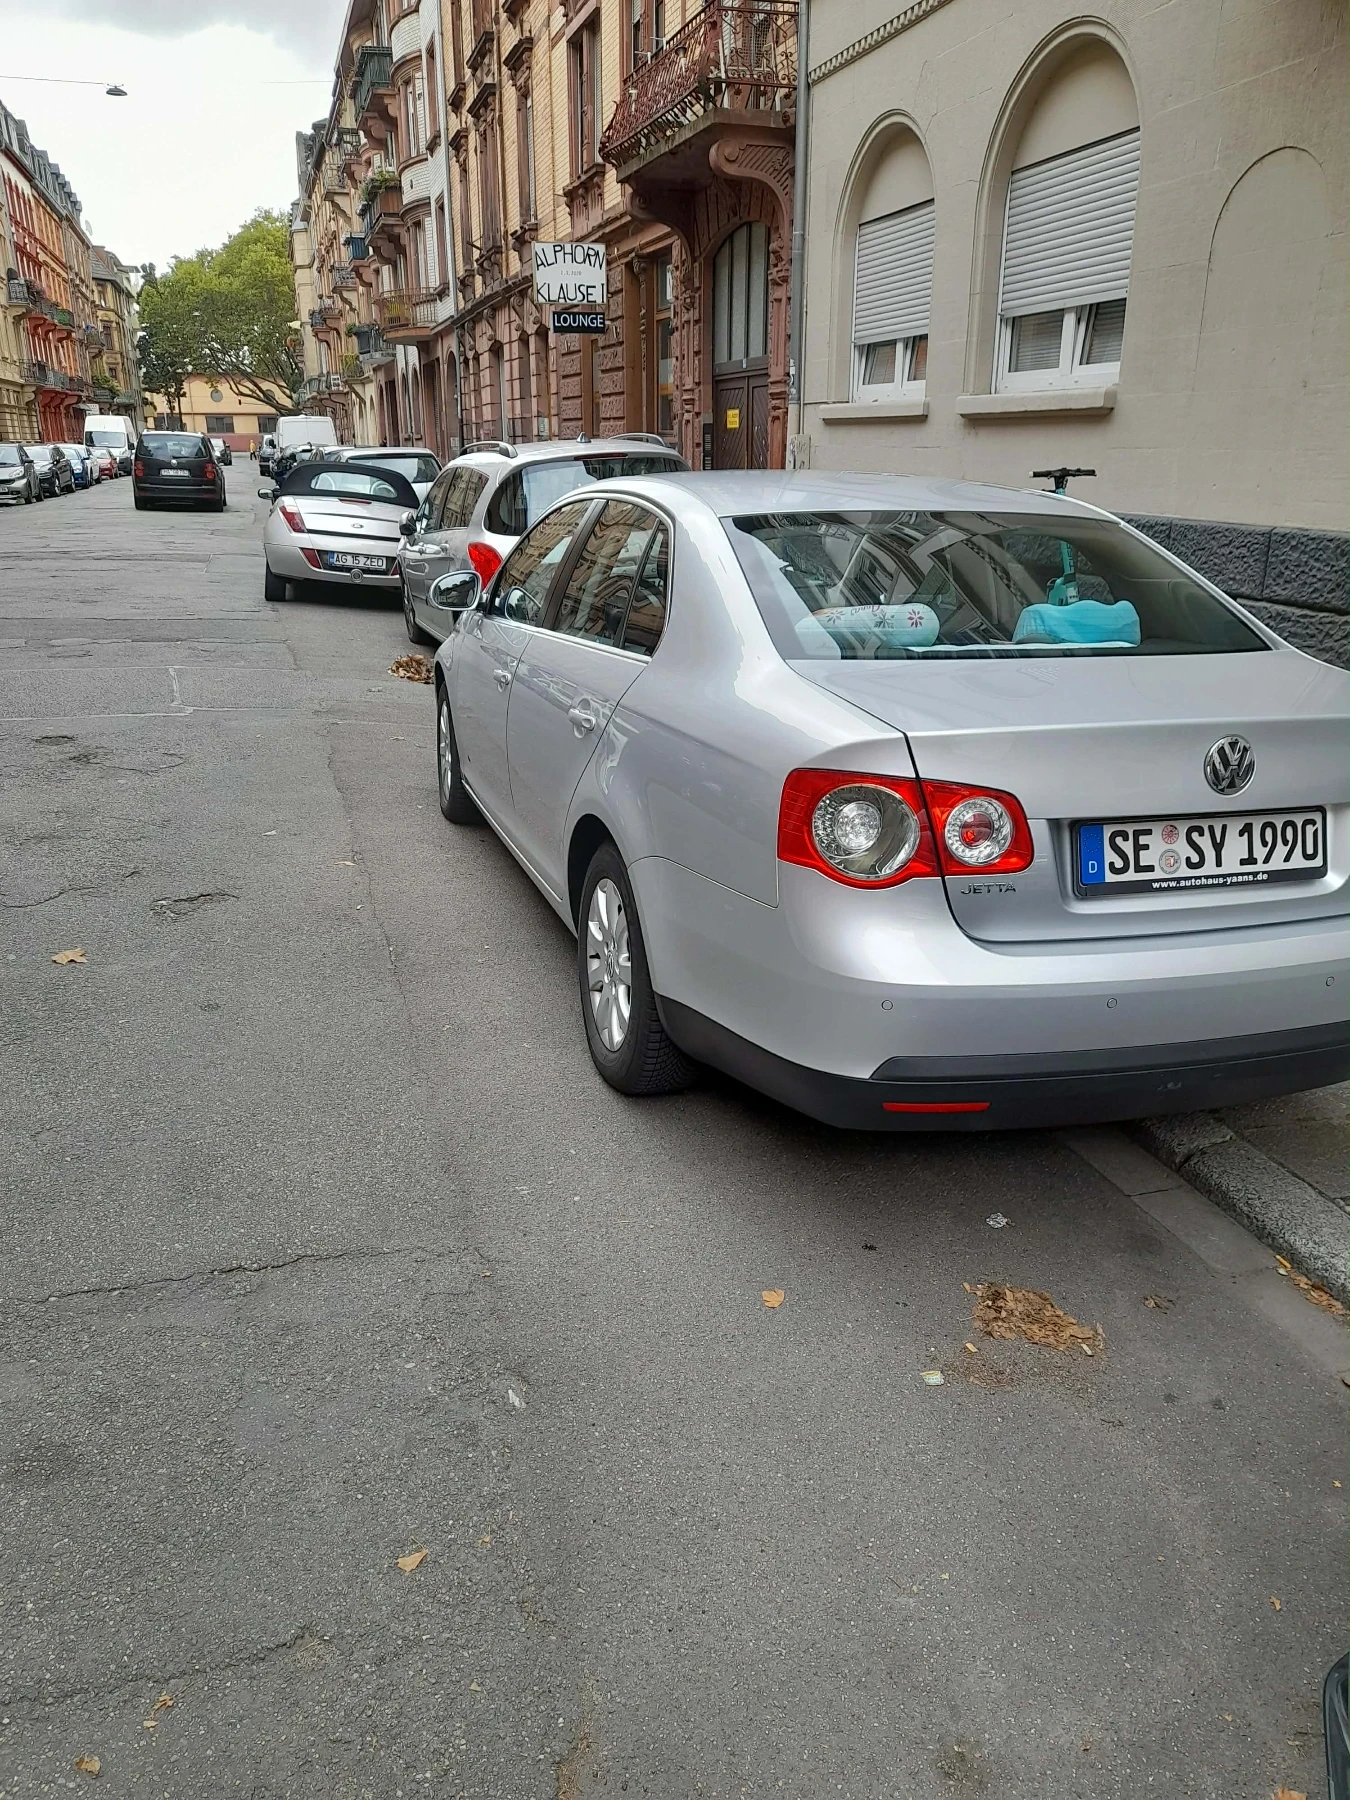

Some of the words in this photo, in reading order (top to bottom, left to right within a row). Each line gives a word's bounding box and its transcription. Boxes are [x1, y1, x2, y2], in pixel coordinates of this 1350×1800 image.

[535, 244, 605, 271] ALPHORN
[536, 282, 597, 303] KLAUSE
[554, 313, 604, 327] LOUNGE
[335, 554, 348, 564] AG
[351, 555, 361, 565] 15
[363, 556, 384, 568] ZED
[1088, 860, 1098, 874] D
[1108, 829, 1155, 876] SE
[1185, 823, 1228, 870] SY
[1238, 818, 1319, 867] 1990
[960, 882, 1017, 895] JETTA
[1152, 872, 1268, 889] www.autohaus-yaans.de
